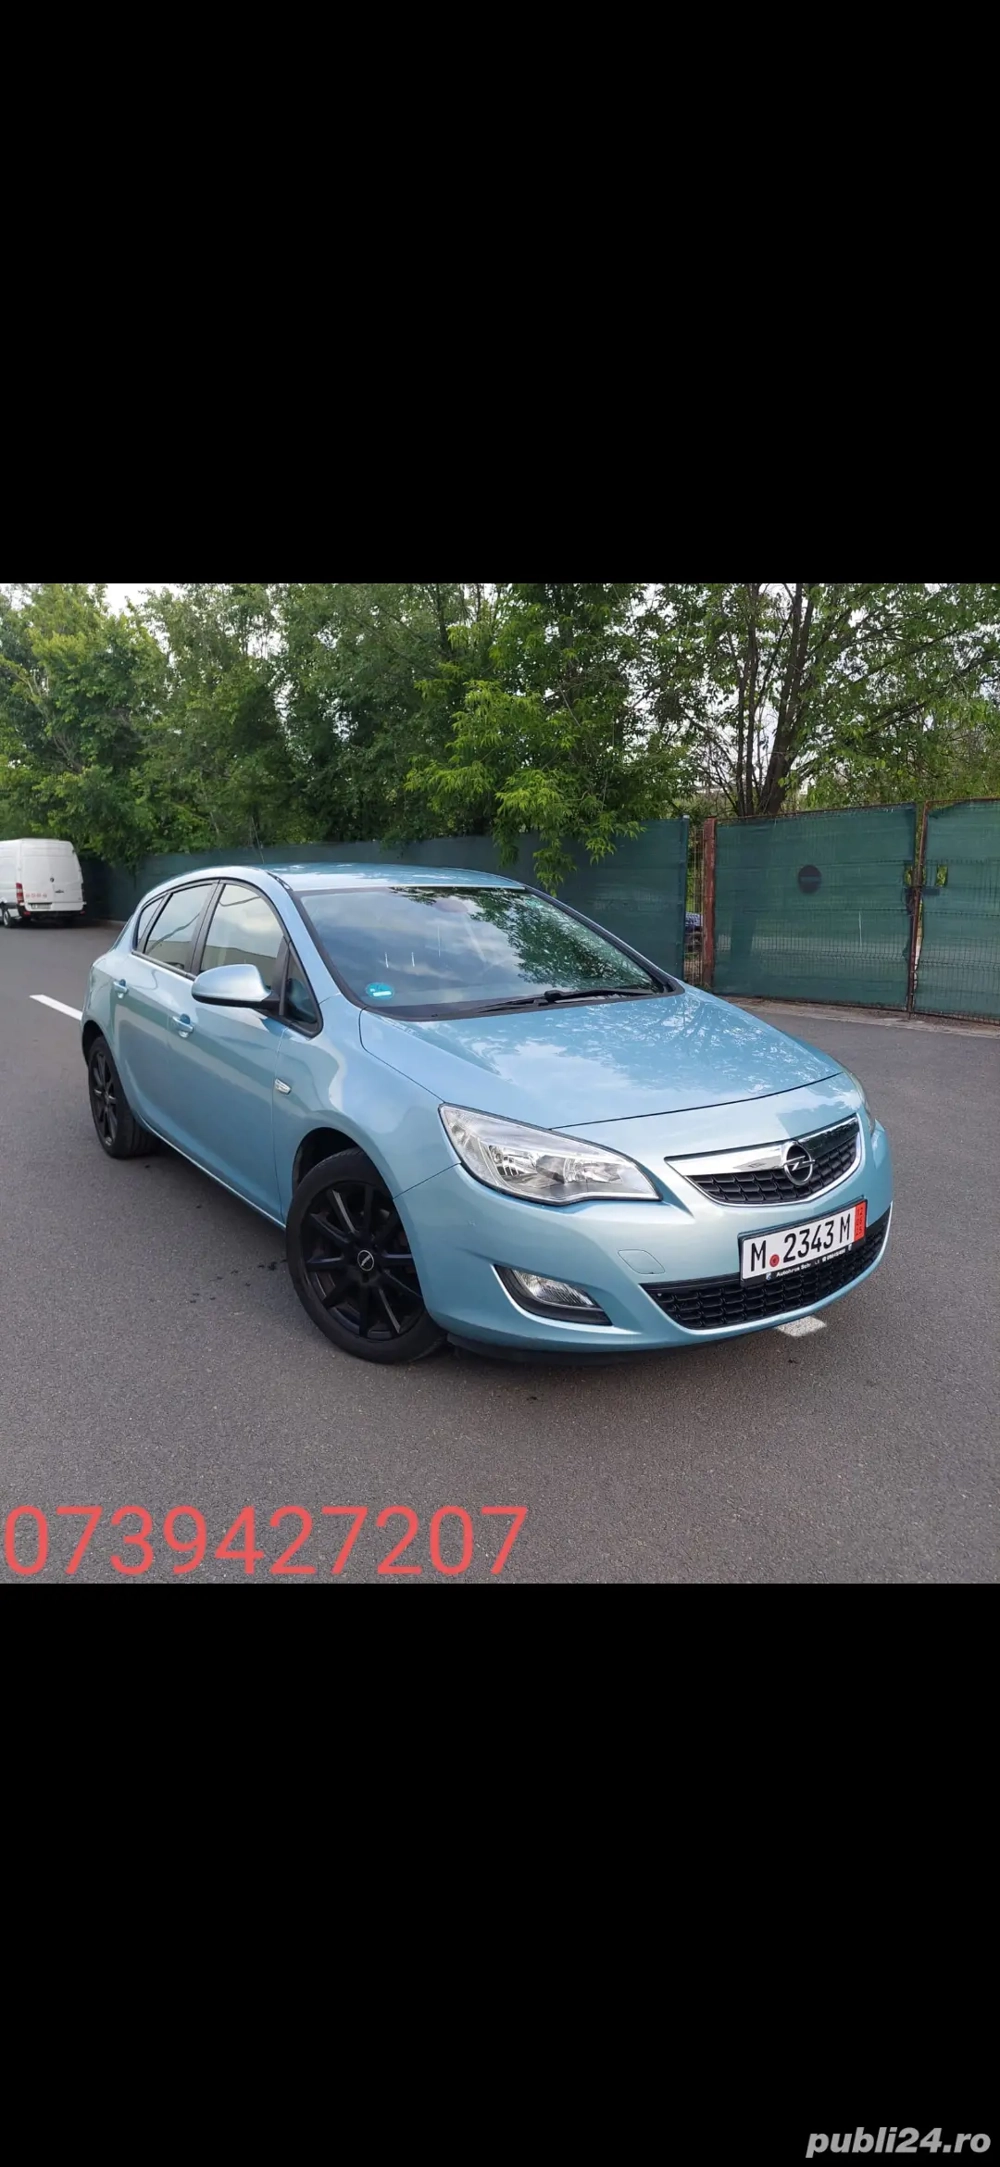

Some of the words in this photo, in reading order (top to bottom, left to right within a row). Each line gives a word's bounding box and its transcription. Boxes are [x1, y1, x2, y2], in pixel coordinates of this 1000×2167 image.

[751, 1240, 766, 1272] M
[783, 1220, 834, 1263] 2343
[839, 1213, 850, 1243] M
